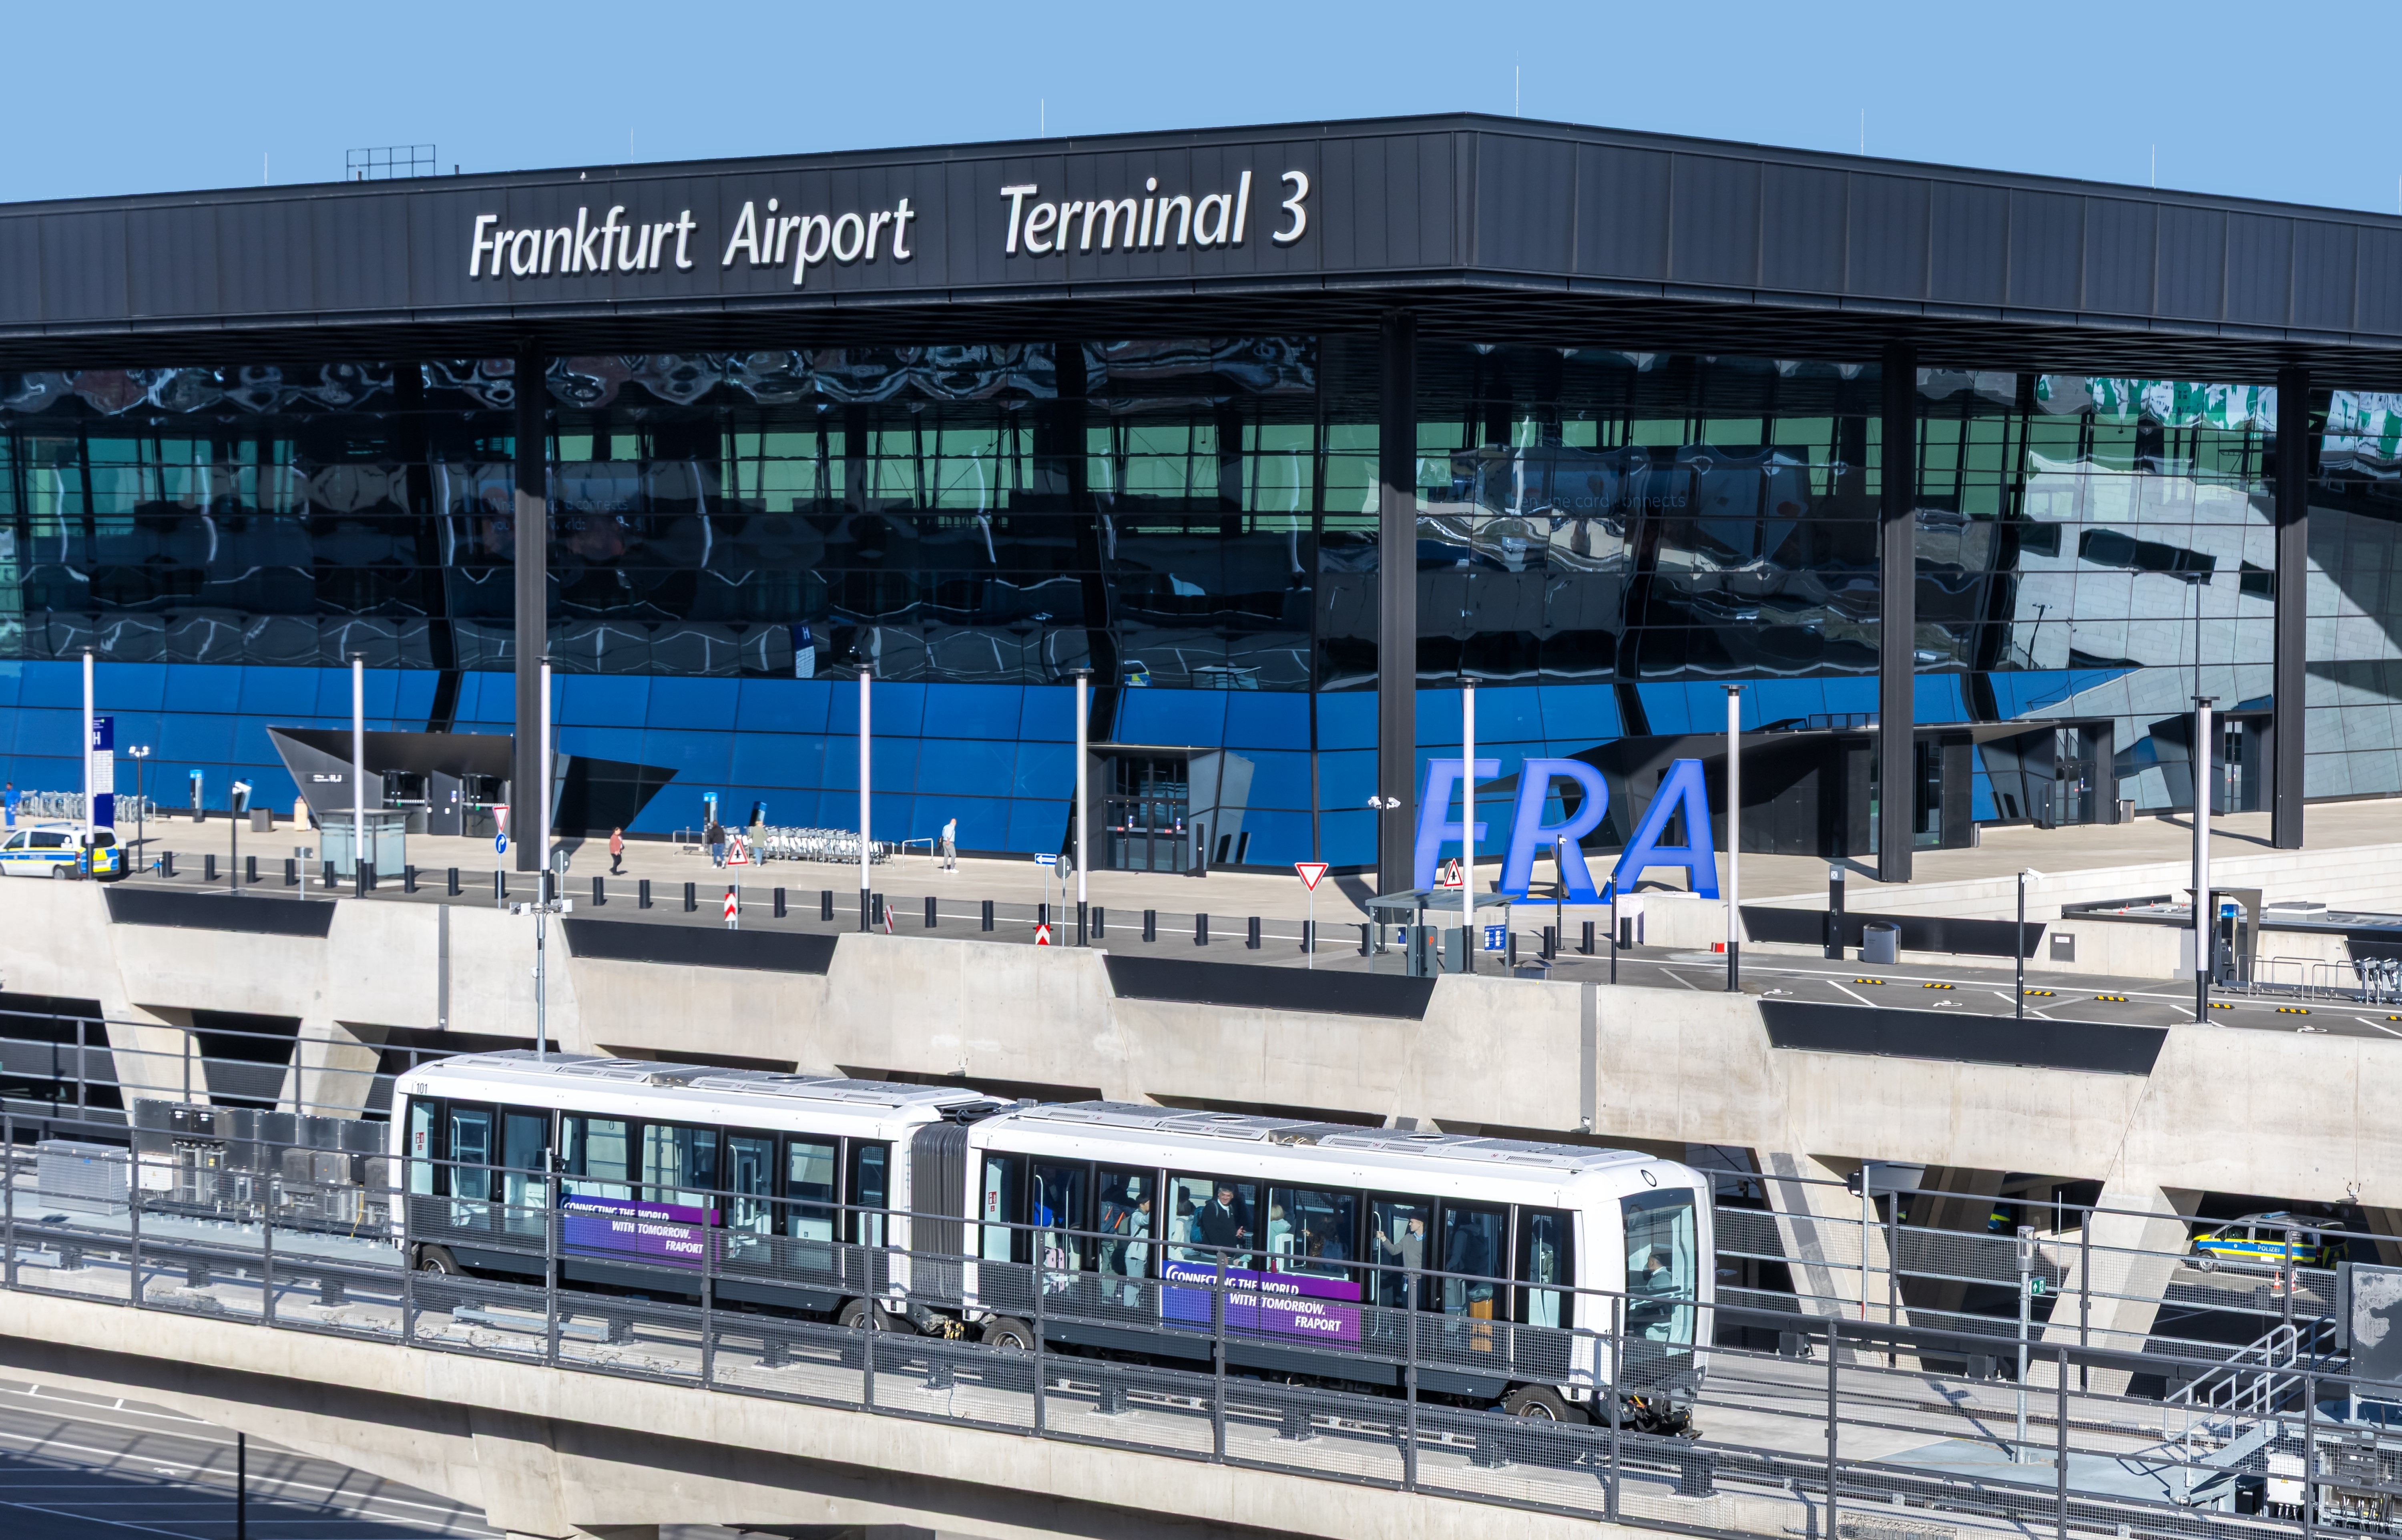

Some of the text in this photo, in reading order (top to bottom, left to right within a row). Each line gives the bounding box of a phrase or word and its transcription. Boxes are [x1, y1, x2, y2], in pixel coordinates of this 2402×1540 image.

[469, 171, 1309, 285] Frankfurt Airport Terminal 3
[1575, 493, 1609, 508] card
[1614, 496, 1685, 508] onnects
[93, 731, 101, 745] H
[1414, 758, 1720, 904] FRA
[417, 1082, 428, 1094] 101
[564, 1202, 670, 1221] CONNECTING THE WORLD
[612, 1221, 691, 1239] WITH TOMORROW.
[666, 1240, 703, 1254] FRAPORT
[2257, 1245, 2280, 1253] POLIZEI
[1171, 1271, 1299, 1295] CONNECTNG THE WORLD
[1230, 1293, 1326, 1315] WITH TOMORROW.
[1295, 1316, 1342, 1332] FRAPORT
